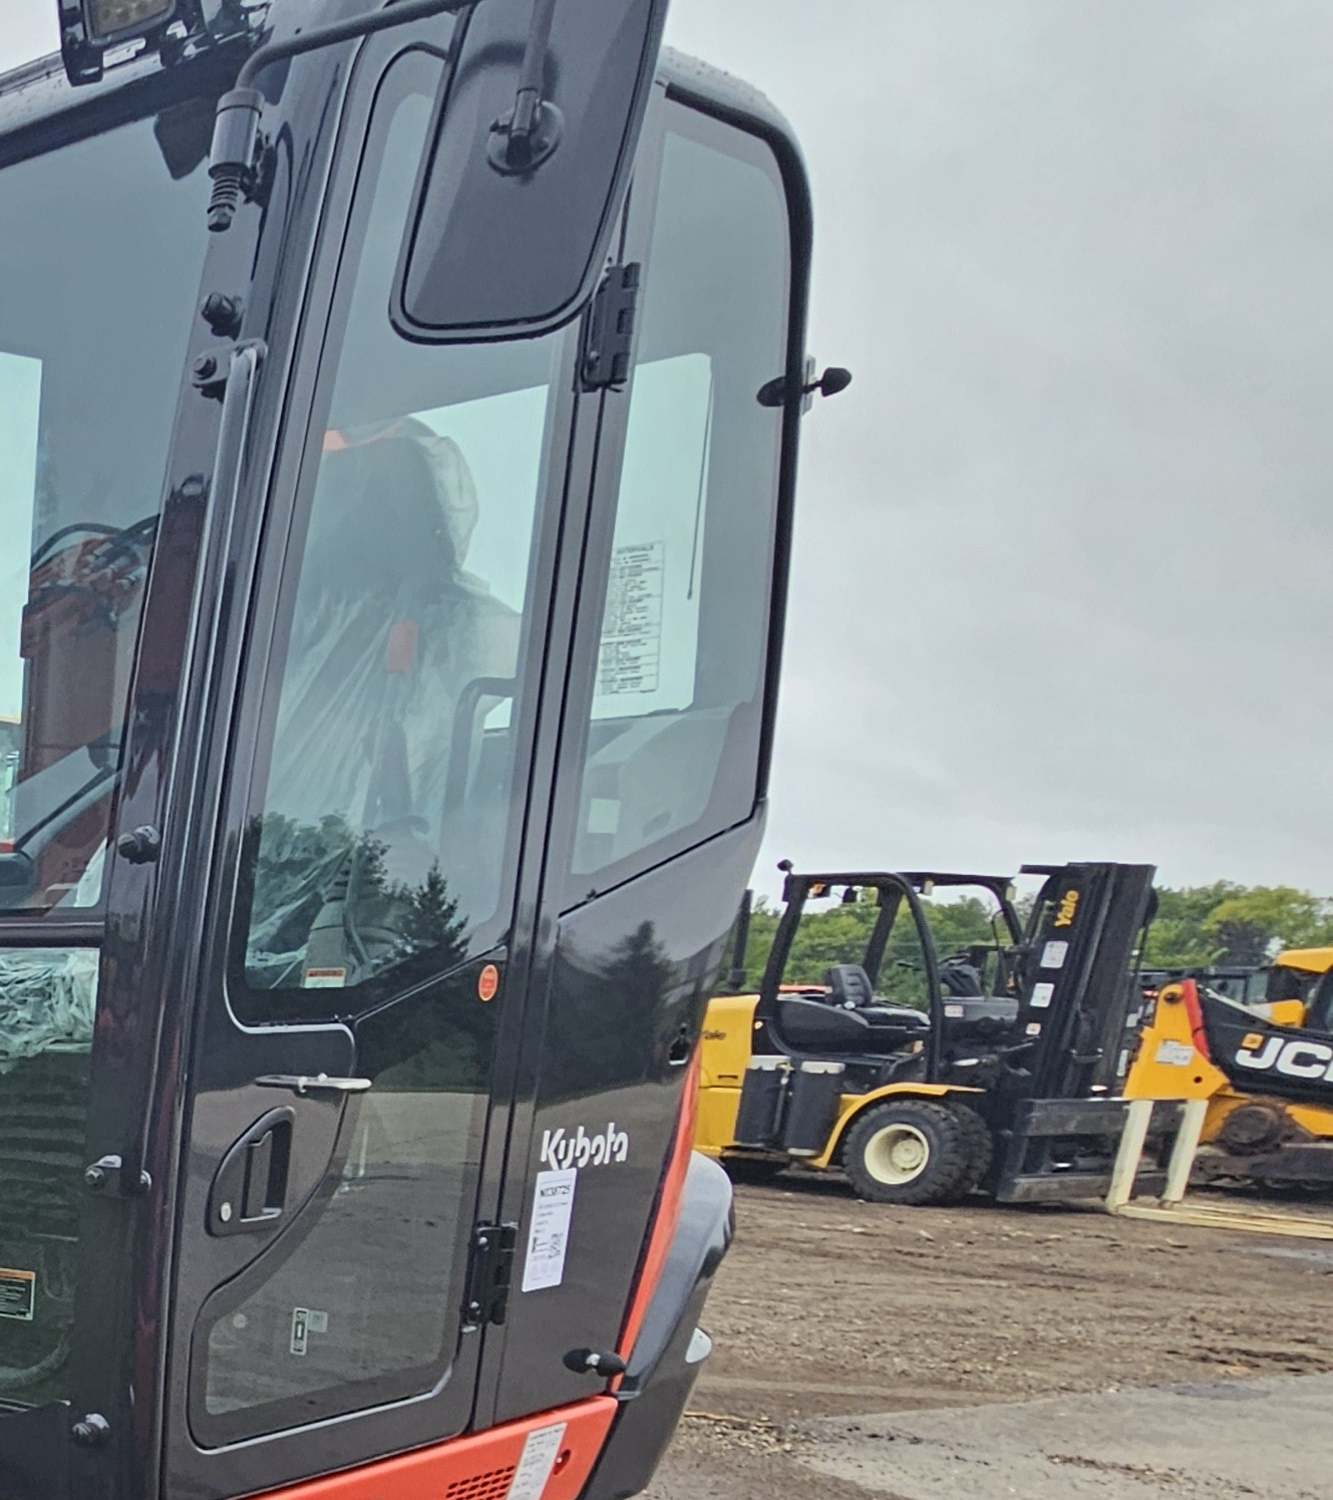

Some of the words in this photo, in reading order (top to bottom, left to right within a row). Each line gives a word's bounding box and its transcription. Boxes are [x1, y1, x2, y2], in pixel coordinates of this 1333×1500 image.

[1054, 890, 1079, 927] Yale
[1235, 1037, 1333, 1083] JC
[540, 1122, 629, 1171] Kubota
